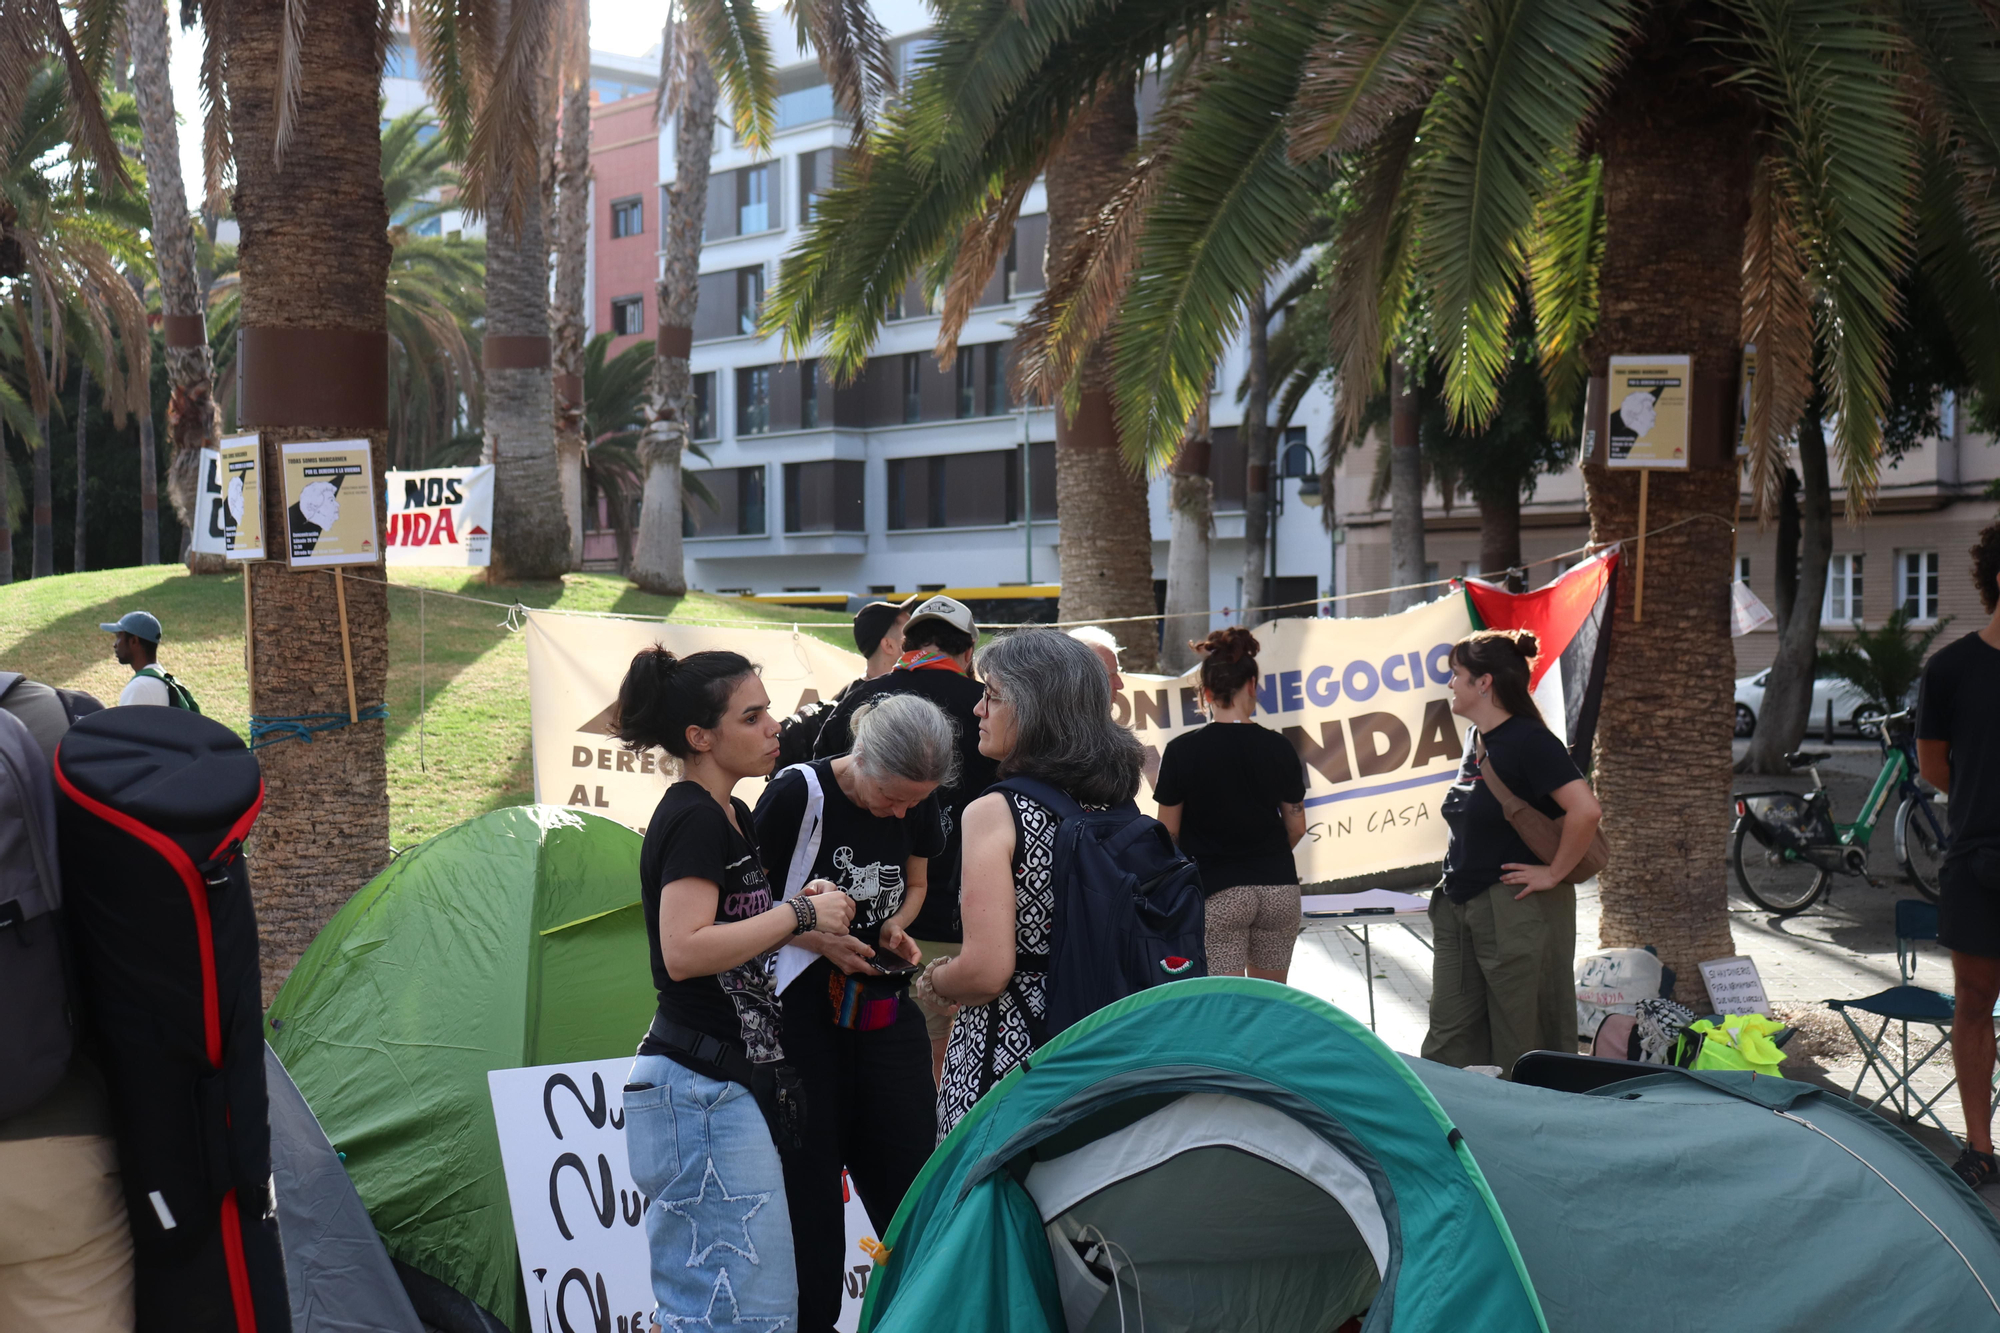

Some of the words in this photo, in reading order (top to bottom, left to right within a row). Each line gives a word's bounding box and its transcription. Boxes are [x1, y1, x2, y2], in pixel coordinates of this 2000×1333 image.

[403, 477, 463, 510] NOS
[1270, 698, 1463, 790] NDA
[567, 784, 609, 808] AL
[1306, 816, 1351, 842] SIN
[1367, 802, 1429, 833] CASA
